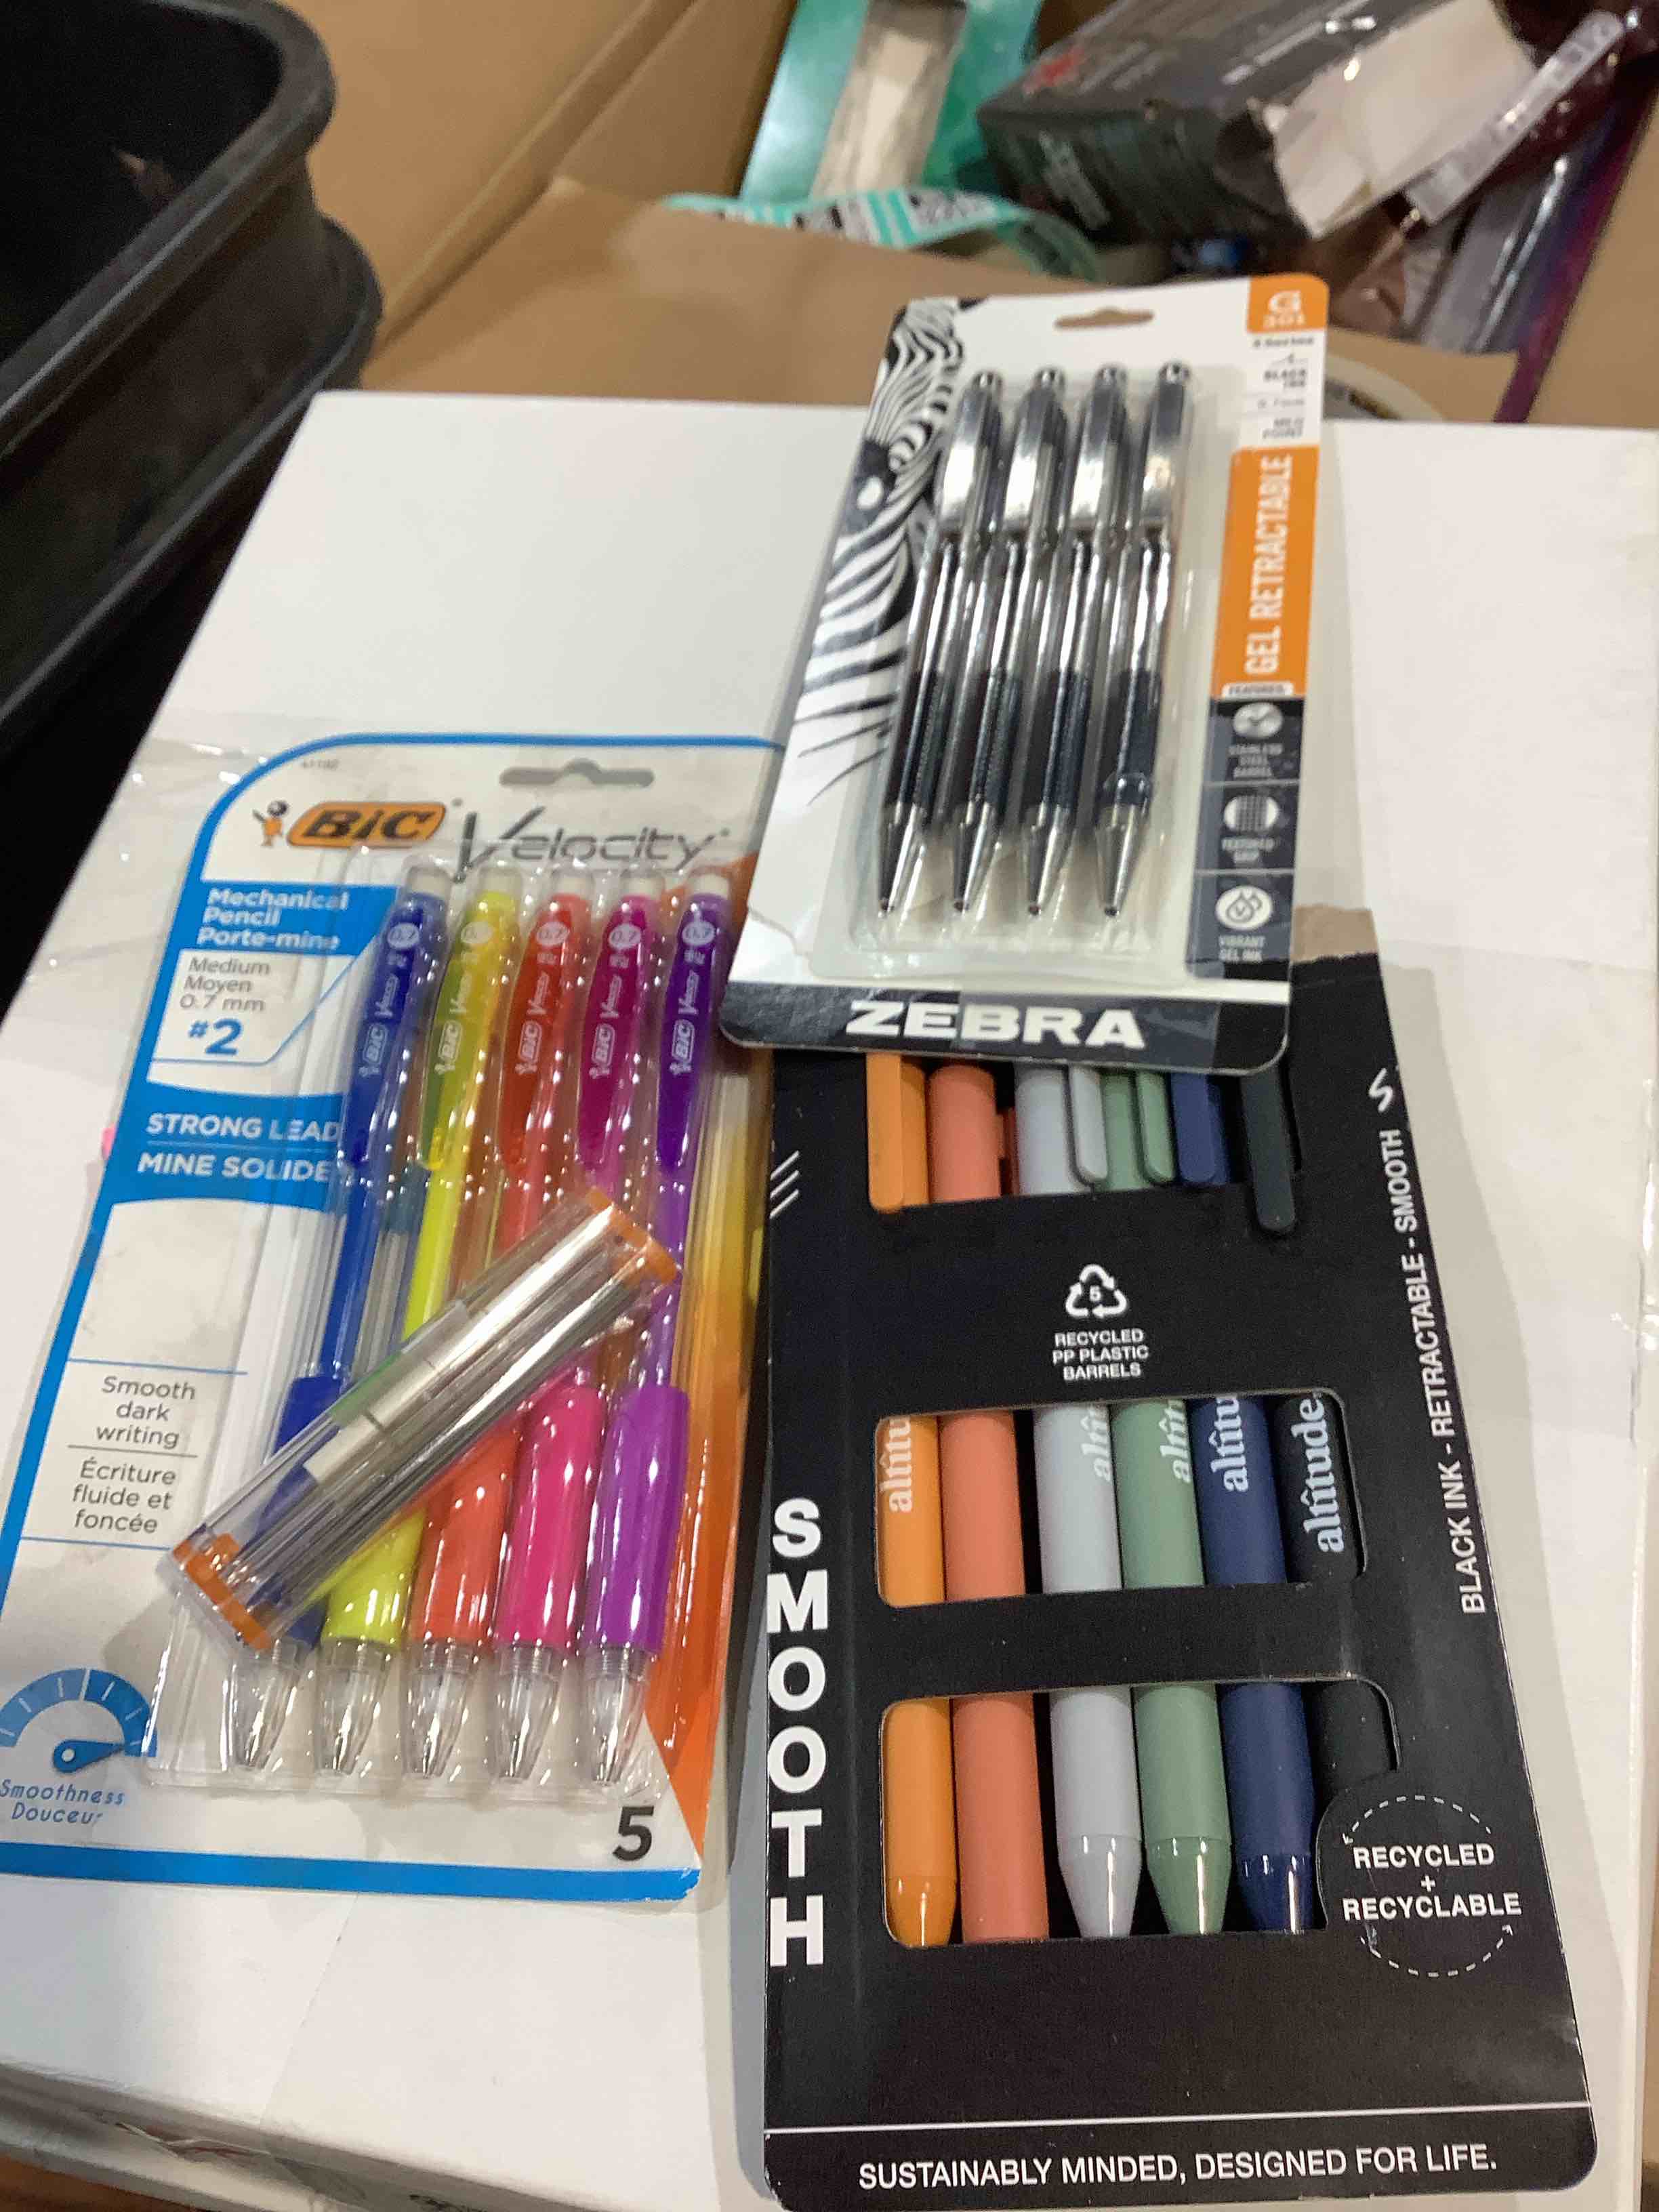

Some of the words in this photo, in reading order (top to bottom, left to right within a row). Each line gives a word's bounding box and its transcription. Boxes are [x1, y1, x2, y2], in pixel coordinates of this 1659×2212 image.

[1249, 454, 1292, 620] RETRACTABLE
[1244, 626, 1282, 675] GEL
[302, 809, 431, 841] BIC
[455, 806, 716, 882] Velocity
[207, 888, 350, 910] Mechanical
[203, 905, 282, 926] Pencil
[197, 926, 340, 950] Porte-mine
[188, 958, 270, 975] Medium
[184, 977, 251, 995] Moyen
[180, 995, 216, 1010] 0.7
[221, 998, 266, 1012] mm
[188, 1019, 243, 1055] #2
[845, 1000, 1145, 1049] ZEBRA
[146, 1112, 262, 1136] STRONG
[268, 1119, 341, 1142] LEAD
[138, 1153, 215, 1176] MINE
[221, 1155, 331, 1182] SOLIDE
[1379, 1129, 1417, 1233] SMOOTH
[1054, 1328, 1144, 1347] RECYCLED
[1401, 1253, 1456, 1437] RETRACTABLE
[1052, 1349, 1074, 1365] PP
[1079, 1345, 1149, 1363] PLASTIC
[1063, 1362, 1141, 1381] BARRELS
[102, 1376, 196, 1400] Smooth
[117, 1401, 169, 1421] dark
[97, 1425, 179, 1450] writing
[81, 1458, 176, 1485] Écriture
[1438, 1460, 1468, 1509] INK
[73, 1485, 140, 1507] fluide
[148, 1493, 173, 1510] et
[75, 1510, 157, 1533] foncée
[1448, 1516, 1486, 1614] BLACK
[766, 1498, 828, 1967] SMOOTH
[0, 1779, 125, 1805] Smoothness
[12, 1802, 103, 1825] Douceur
[613, 1805, 655, 1861] 5
[1353, 1843, 1494, 1869] RECYCLED
[1343, 1892, 1522, 1921] RECYCLABLE
[859, 2156, 1052, 2190] SUSTAINABLY
[1061, 2154, 1186, 2185] MINDED,
[1195, 2148, 1347, 2180] DESIGNED
[1356, 2146, 1418, 2175] FOR
[1426, 2142, 1497, 2172] LIFE.
